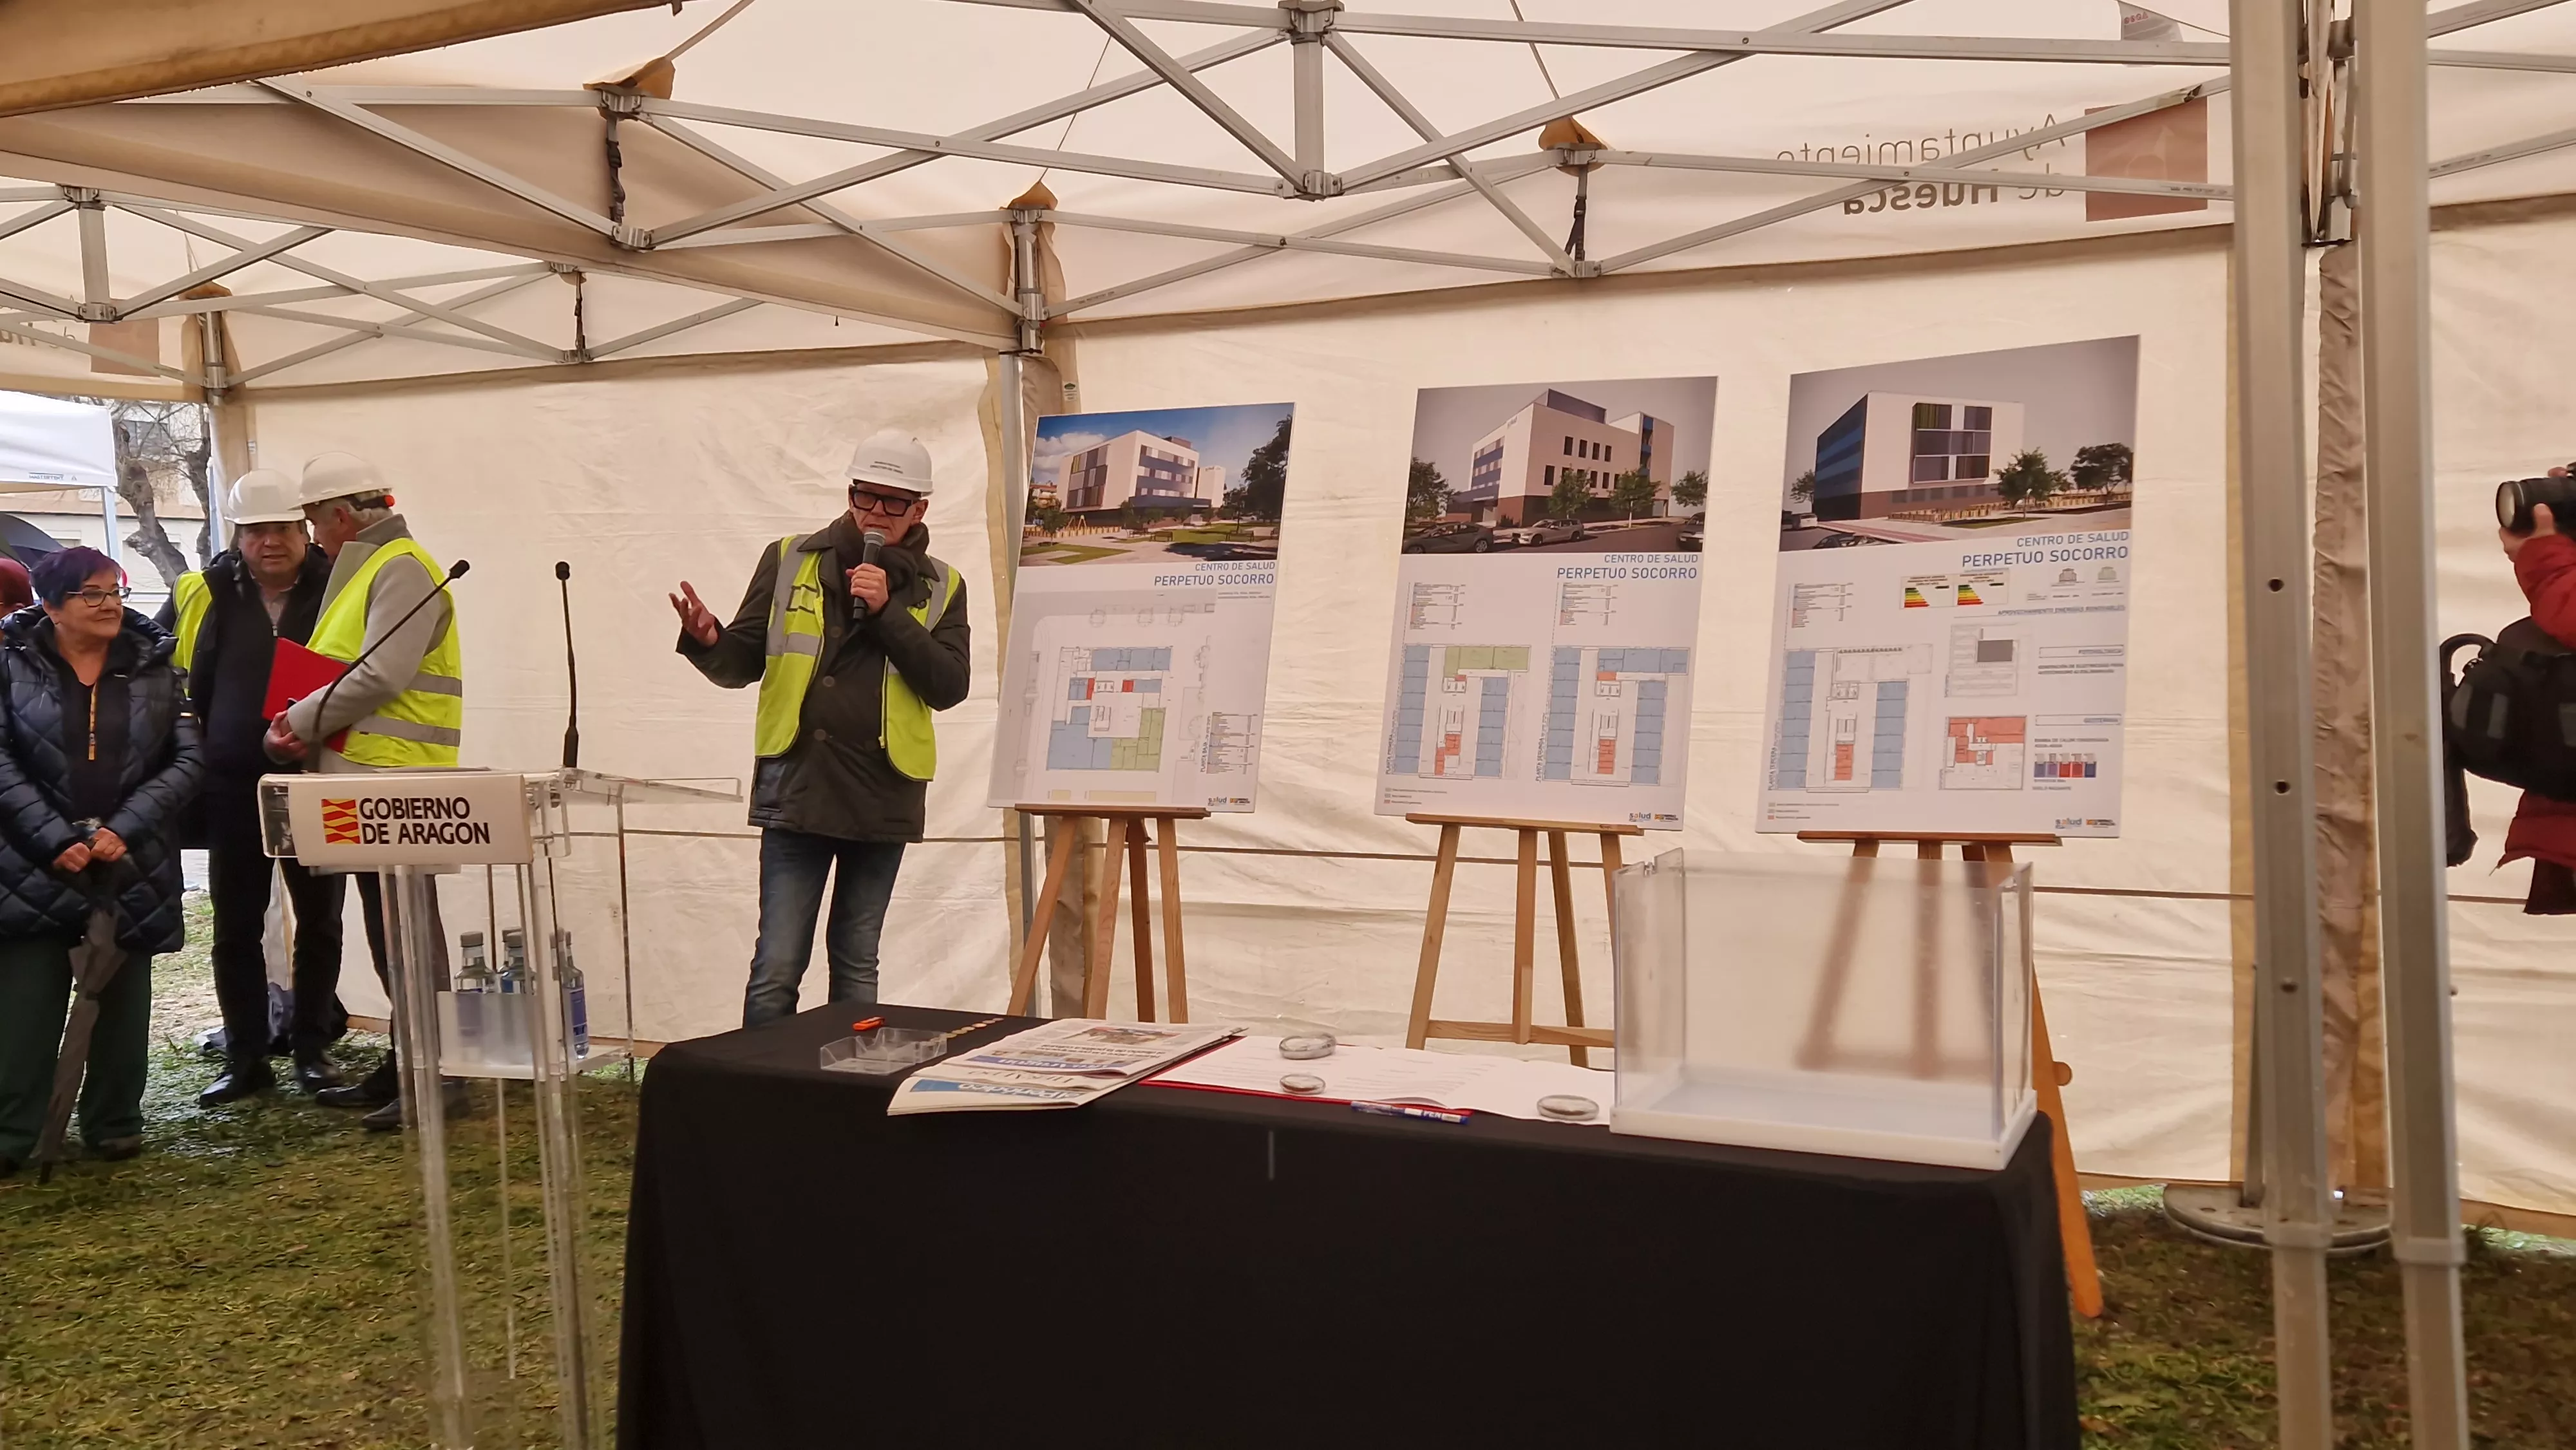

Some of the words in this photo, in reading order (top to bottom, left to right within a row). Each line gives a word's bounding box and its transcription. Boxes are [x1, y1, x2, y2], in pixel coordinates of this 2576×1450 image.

[2017, 535, 2064, 547] CENTRO
[2067, 534, 2084, 544] DE
[2087, 531, 2129, 543] SALUD
[1604, 554, 1643, 563] CENTRO
[1647, 554, 1660, 563] DE
[1663, 554, 1698, 563] SALUD
[1962, 551, 2044, 567] PERPETUO
[2049, 546, 2129, 563] SOCORRO
[1195, 563, 1229, 571] CENTRO
[1231, 562, 1244, 570] DE
[1245, 561, 1275, 570] SALUD
[1557, 567, 1627, 579] PERPETUO
[1631, 567, 1697, 579] SOCORRO
[1154, 575, 1214, 586] PERPETUO
[1218, 574, 1274, 585] SOCORRO
[359, 797, 470, 820] GOBIERNO
[361, 823, 390, 845] DE
[397, 822, 490, 845] ARAGON
